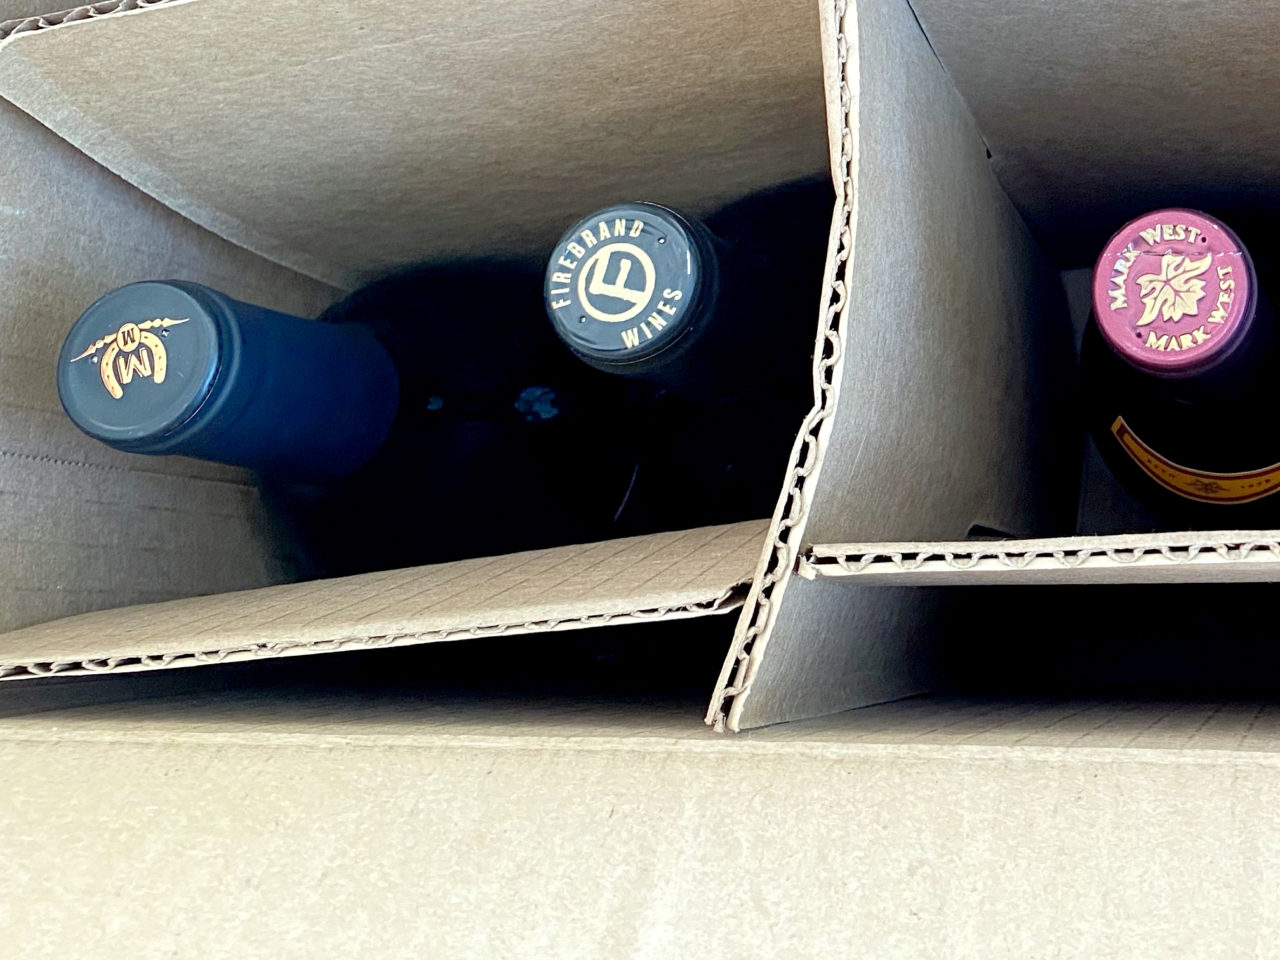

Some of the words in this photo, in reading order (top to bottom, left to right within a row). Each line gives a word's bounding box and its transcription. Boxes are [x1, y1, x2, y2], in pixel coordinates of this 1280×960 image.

[551, 218, 644, 310] FIREBRAND
[1108, 242, 1141, 310] MARK
[1139, 224, 1201, 246] WEST
[620, 287, 683, 350] WINES
[1145, 326, 1211, 352] MARK
[1208, 266, 1235, 324] WEST
